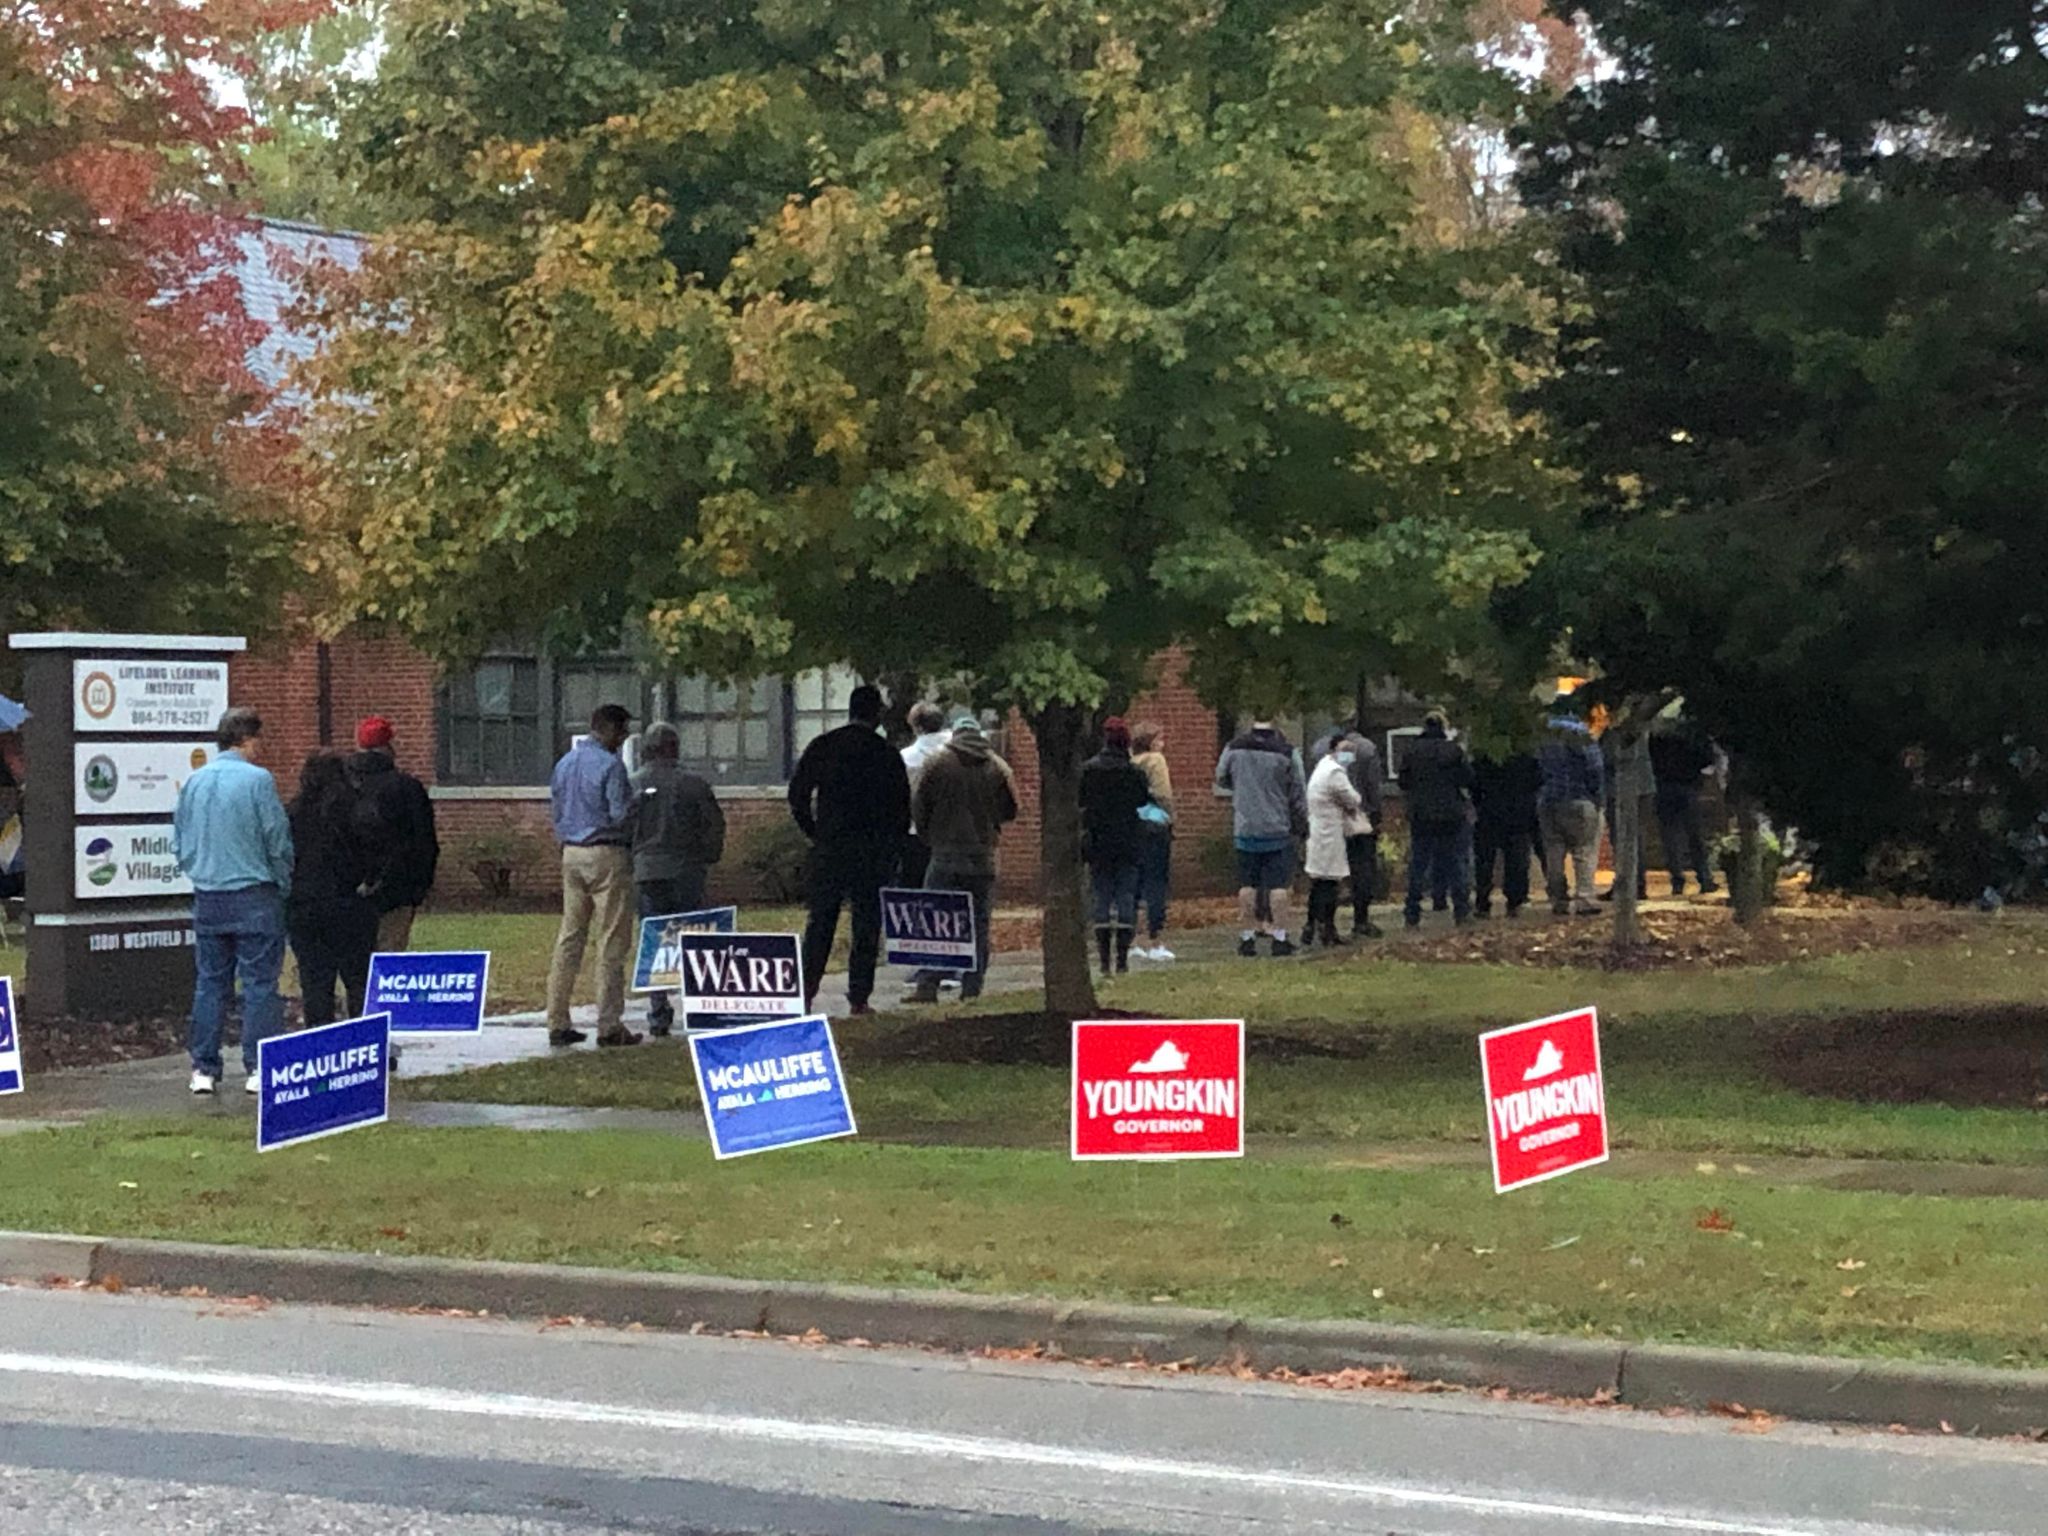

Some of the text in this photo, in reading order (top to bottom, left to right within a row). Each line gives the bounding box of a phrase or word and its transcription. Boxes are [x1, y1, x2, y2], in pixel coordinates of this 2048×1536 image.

[119, 667, 221, 681] LIFELONG LEARNING
[145, 682, 195, 695] INSTITUTE
[126, 862, 182, 883] Village
[887, 902, 969, 938] WARE
[123, 930, 182, 949] WESTFIELD
[378, 973, 477, 990] MCAULIFFE
[686, 949, 798, 993] WARE
[377, 991, 475, 1003] AYALA HERRING
[701, 999, 786, 1012] DELEGATE
[271, 1043, 379, 1088] MCAULIFFE
[707, 1051, 827, 1091] MCAULIFFE
[274, 1067, 379, 1104] AYALA HERRING
[717, 1077, 832, 1110] AYALA HERRING
[1082, 1078, 1236, 1119] YOUNGKIN
[1493, 1072, 1600, 1141] YOUNGKIN
[1113, 1119, 1204, 1134] GOVERNOR
[1519, 1121, 1581, 1152] GOVERNOR
